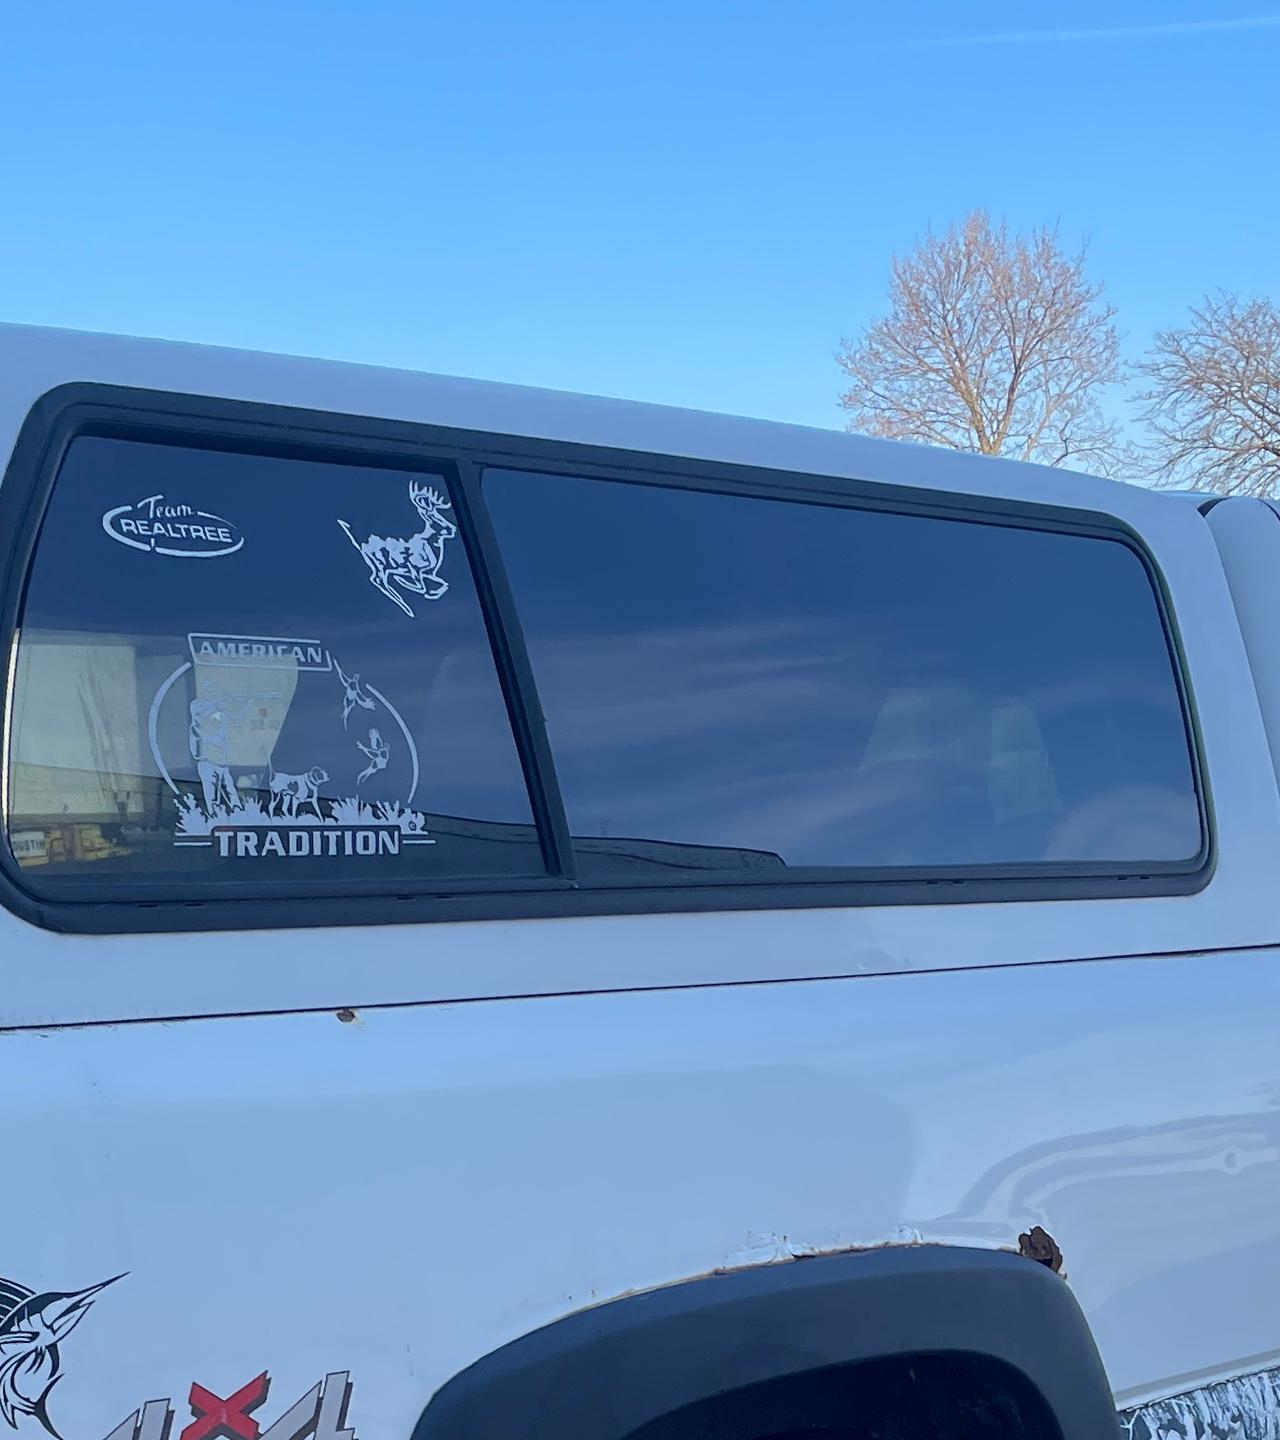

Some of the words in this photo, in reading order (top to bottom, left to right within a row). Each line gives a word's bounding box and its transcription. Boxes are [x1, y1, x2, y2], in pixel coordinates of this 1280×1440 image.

[137, 494, 194, 518] Team
[119, 518, 233, 543] REALTREE
[200, 641, 322, 663] AMERICAN
[214, 829, 400, 857] TRADITION
